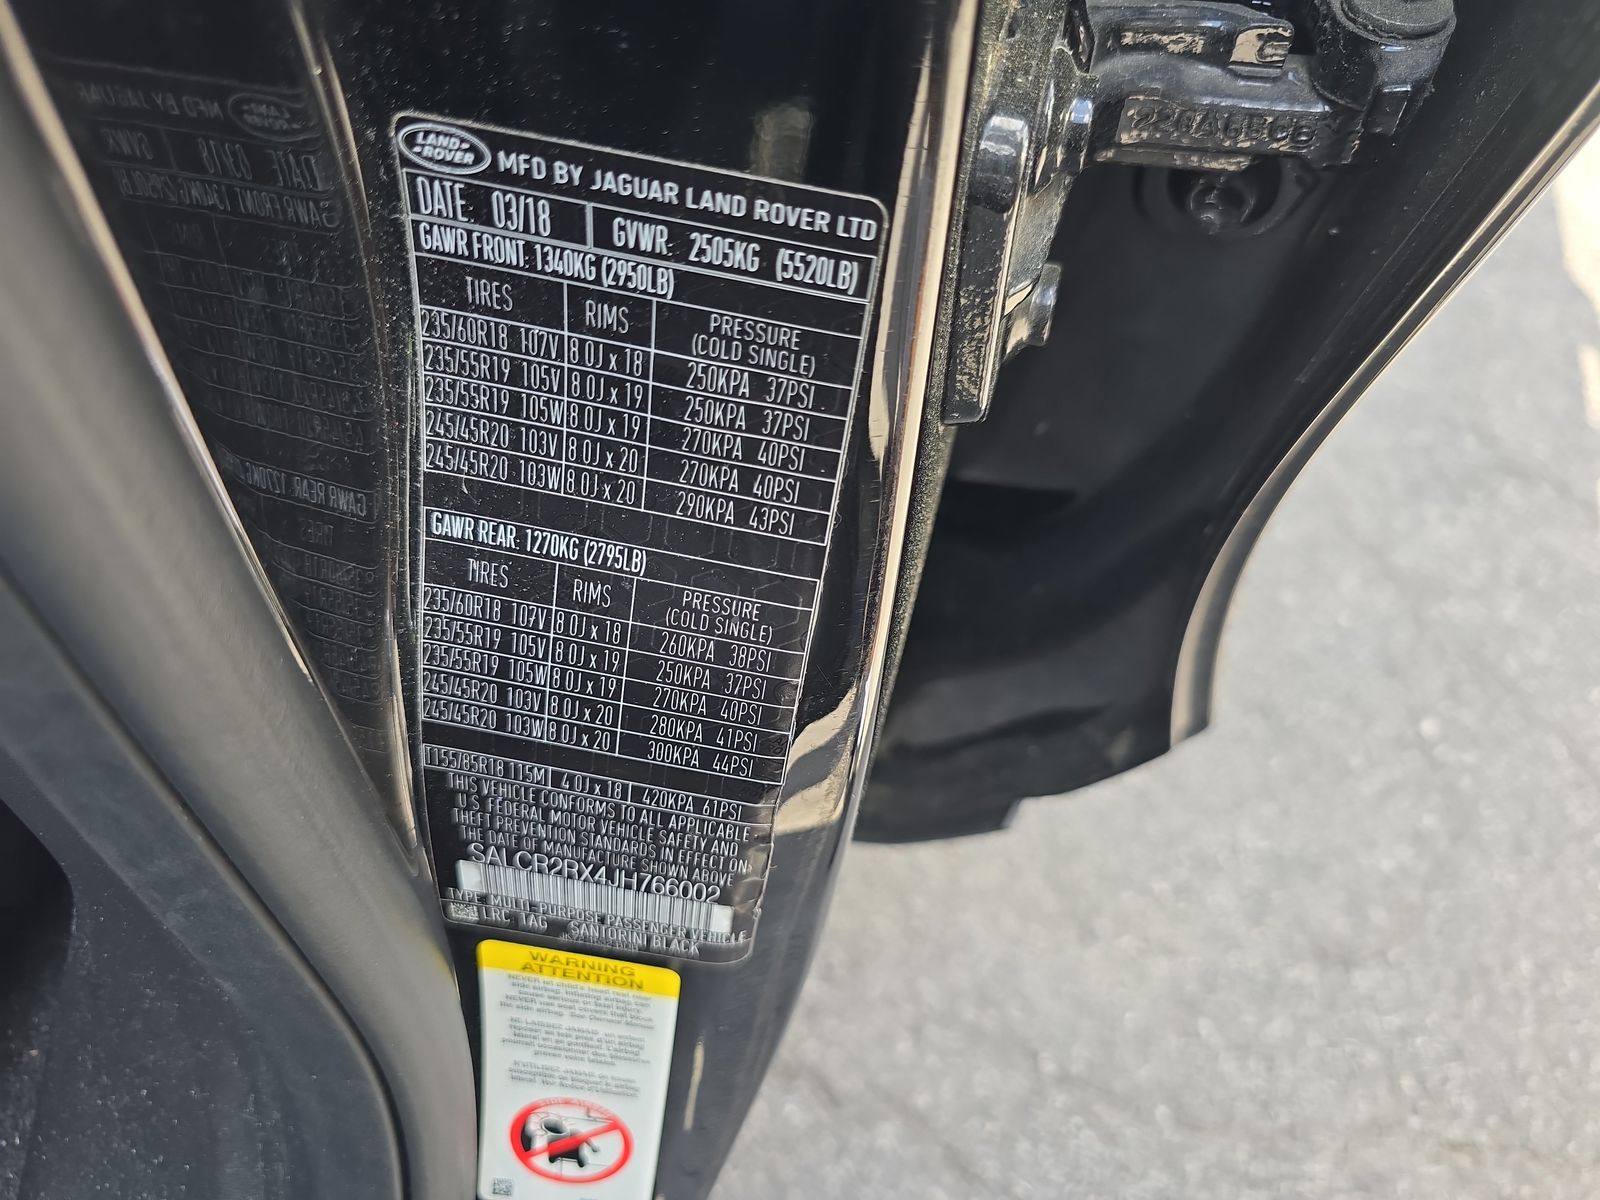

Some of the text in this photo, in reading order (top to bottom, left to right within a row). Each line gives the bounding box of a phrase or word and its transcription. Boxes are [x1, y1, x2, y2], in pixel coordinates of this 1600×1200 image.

[415, 131, 460, 150] LAND
[423, 146, 475, 165] ROVER
[491, 190, 551, 237] 03/18
[497, 150, 878, 242] MFD BY JAGUAR LAND ROVER LTD
[418, 222, 469, 257] GAWR
[534, 243, 596, 281] 1340KG
[601, 257, 675, 300] (2950LB)
[688, 232, 760, 272] 2505KG
[776, 248, 858, 295] (5520LB)
[465, 276, 513, 312] TIRES
[421, 309, 559, 360] 235/60R18 107V
[585, 299, 629, 334] RIMS
[709, 313, 802, 351] PRESSURE
[425, 343, 561, 393] 235/55R19 105V
[624, 348, 643, 377] 18
[691, 332, 816, 378] (COLD SINGLE)
[425, 375, 564, 425] 235/55R19 105W
[624, 382, 643, 409] 19
[686, 362, 816, 410] 250KPA 37PSI
[426, 410, 558, 457] 245/45R20 103V
[623, 413, 641, 440] 19
[684, 395, 810, 442] 250KPA 37PSI
[426, 443, 562, 491] 245/45R20 103W
[619, 446, 639, 473] 20
[682, 426, 805, 472] 270KPA 40PSI
[616, 479, 636, 505] 20
[679, 459, 800, 504] 270KPA 40PSI
[676, 491, 795, 536] 290KPA 43PSI
[430, 511, 475, 541] GAWR
[525, 528, 580, 560] 1270KG
[584, 539, 647, 577] (2795LB)
[466, 558, 509, 588] TIRES
[572, 578, 612, 608] RIMS
[423, 586, 547, 631] 235/60R18 107V
[665, 606, 773, 646] (COLD SINGLE)
[682, 590, 761, 622] PRESSURE
[424, 616, 546, 659] 235/55R19 105V
[605, 620, 621, 645] 18
[659, 631, 772, 673] 260KPA 38PSI
[423, 642, 550, 686] 235/55R19 105W
[604, 649, 620, 673] 19
[656, 659, 767, 700] 250KPA 37PSI
[423, 671, 541, 712] 245/45R20 103V
[600, 676, 616, 698] 19
[653, 686, 762, 726] 270KPA 40PSI
[423, 697, 545, 739] 245/45R20 103W
[595, 703, 613, 726] 20
[650, 714, 757, 752] 280KPA 41PSI
[593, 729, 611, 751] 20
[647, 741, 754, 777] 300KPA 44PSI
[425, 746, 545, 785] T155/85R18 115M
[449, 772, 750, 842] THIS VEHICLE CONFORMS TO ALL APPLICABLE
[607, 780, 622, 800] 18
[642, 788, 742, 821] 420KPA 61PSI
[452, 807, 491, 829] THEFT
[496, 815, 576, 845] PREVENTION
[581, 831, 657, 858] STANDARDS
[660, 847, 675, 862] IN
[678, 849, 724, 870] EFFECT
[487, 798, 545, 823] FEDERAL
[550, 809, 596, 832] MOTOR
[600, 820, 654, 843] VEHICLE
[659, 829, 708, 851] SAFETY
[711, 841, 739, 857] AND
[461, 825, 484, 842] THE
[486, 829, 518, 849] DATE
[523, 836, 539, 851] OF
[540, 840, 636, 870] MANUFACTURE
[641, 858, 689, 880] SHOWN
[467, 842, 721, 904] SALCR2RX4JH766002
[568, 921, 648, 948] SANTORINI
[653, 935, 701, 956] BLACK
[606, 914, 687, 939] PASSENGER
[521, 962, 644, 990] ATTENTION
[528, 950, 636, 977] WARNING
